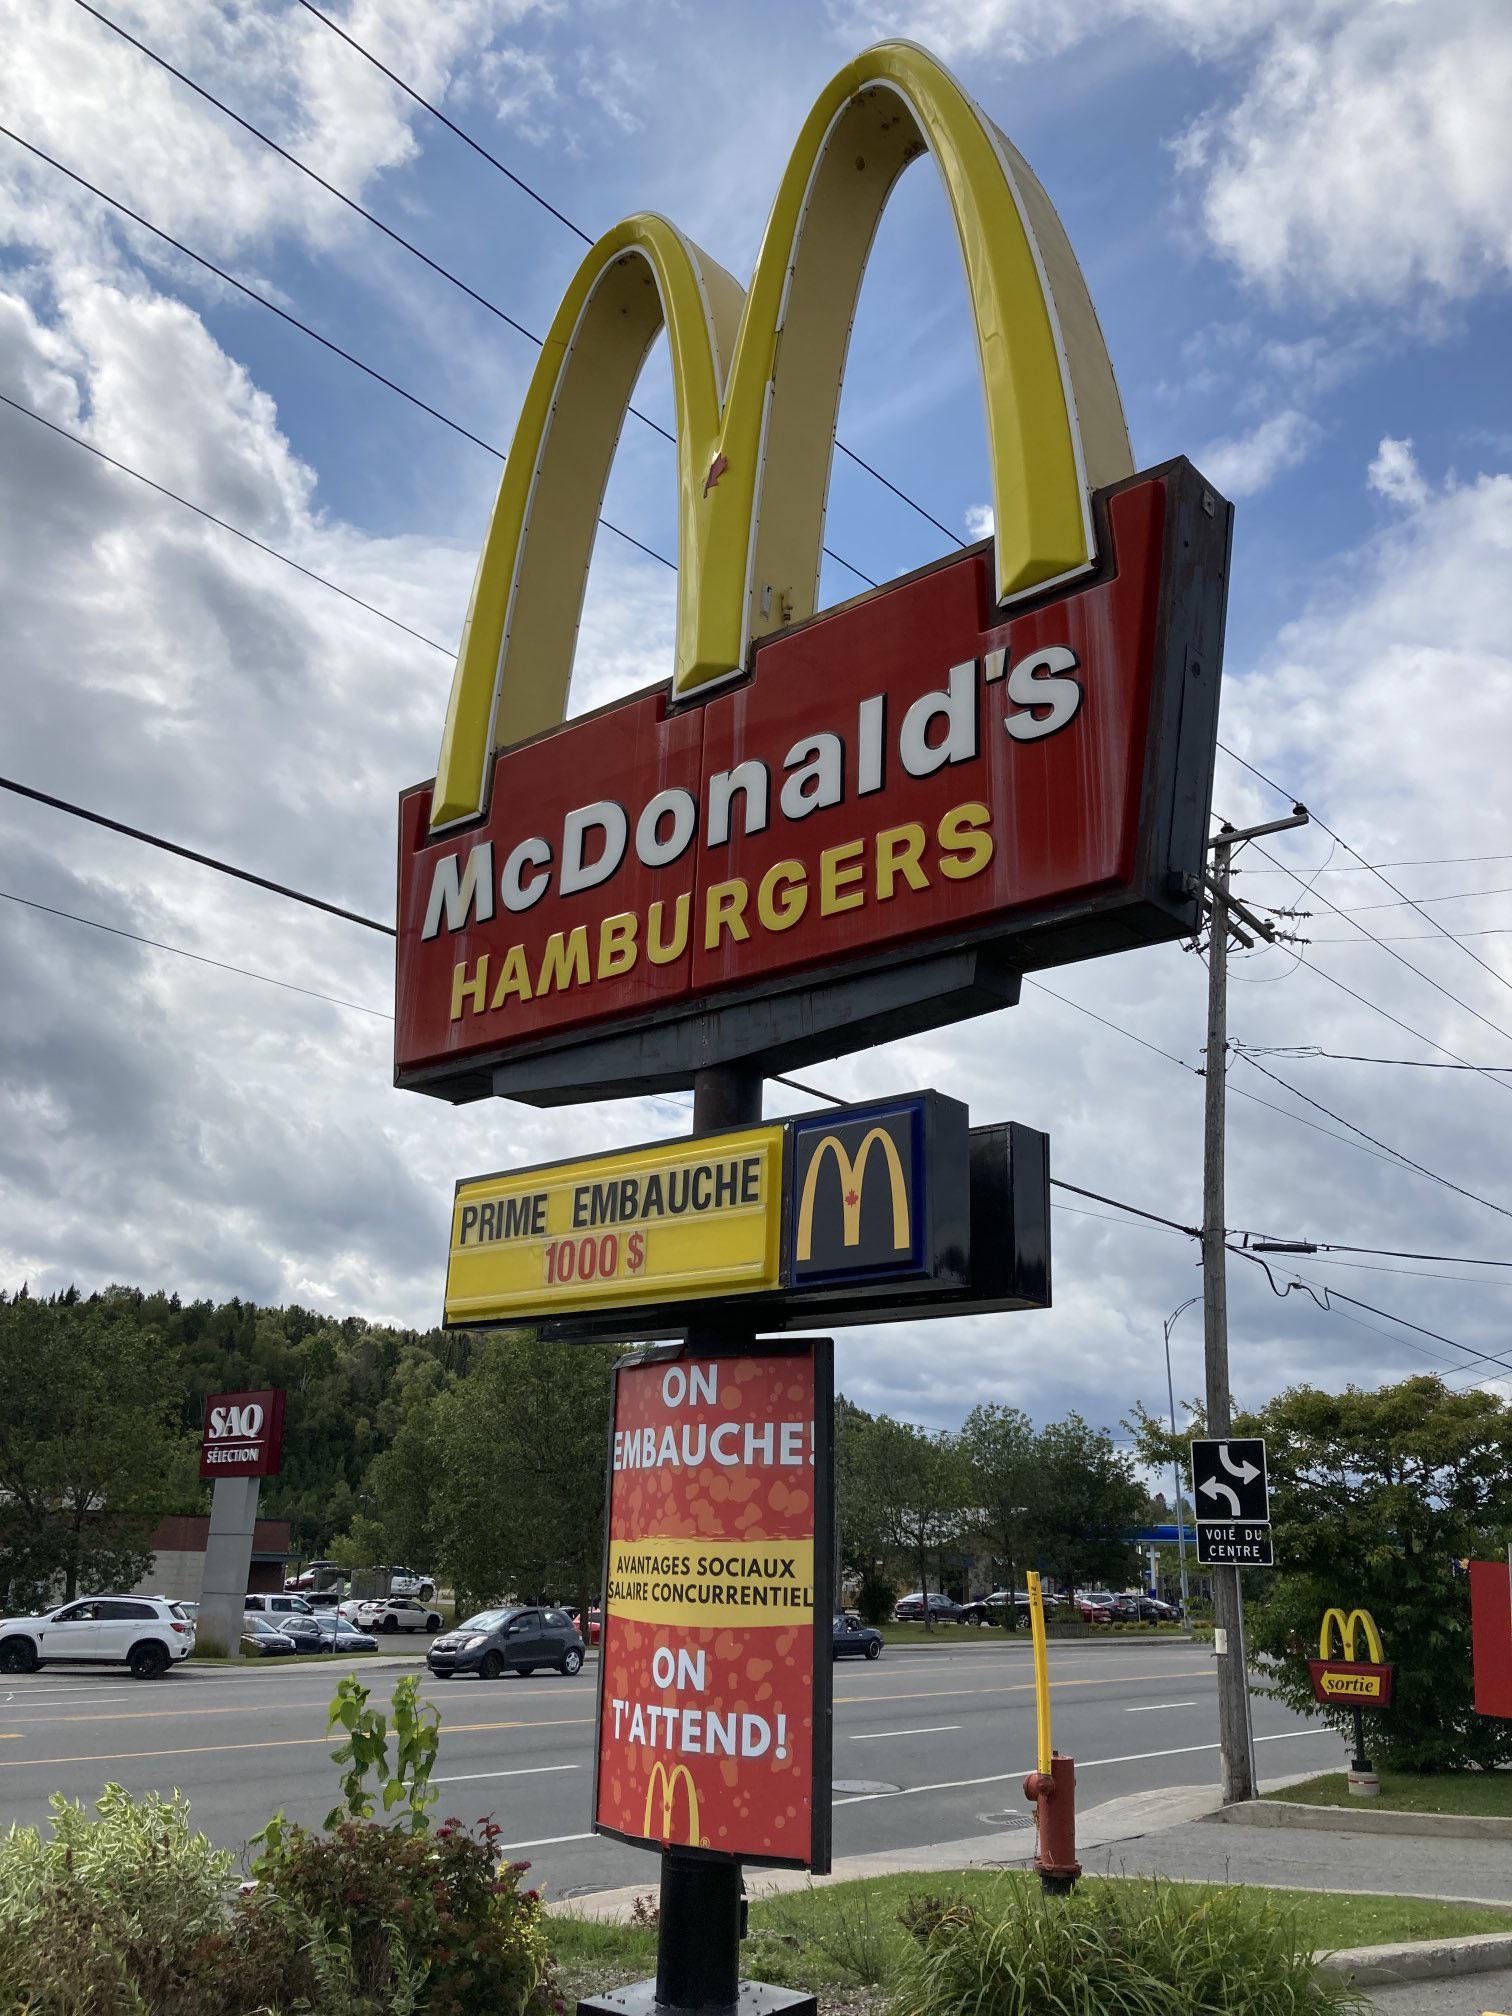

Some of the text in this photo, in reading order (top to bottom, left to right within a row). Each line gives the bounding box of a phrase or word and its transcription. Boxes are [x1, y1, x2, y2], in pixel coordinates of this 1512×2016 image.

[420, 644, 1082, 942] McDonald's
[449, 802, 994, 1022] HAMBURGERS
[460, 1157, 761, 1245] PRIME EMBAUCHE
[662, 1363, 718, 1408] ON
[208, 1403, 263, 1438] SAQ
[1205, 1528, 1262, 1541] VOIE DU
[1209, 1545, 1260, 1557] CENTRE
[616, 1555, 796, 1579] AVANTAGES SOCIAUX
[607, 1580, 814, 1608] SALAIRE CONCURRENTIEL
[652, 1646, 706, 1692] ON
[1326, 1677, 1374, 1693] sortie
[612, 1698, 788, 1761] T'ATTEND!
